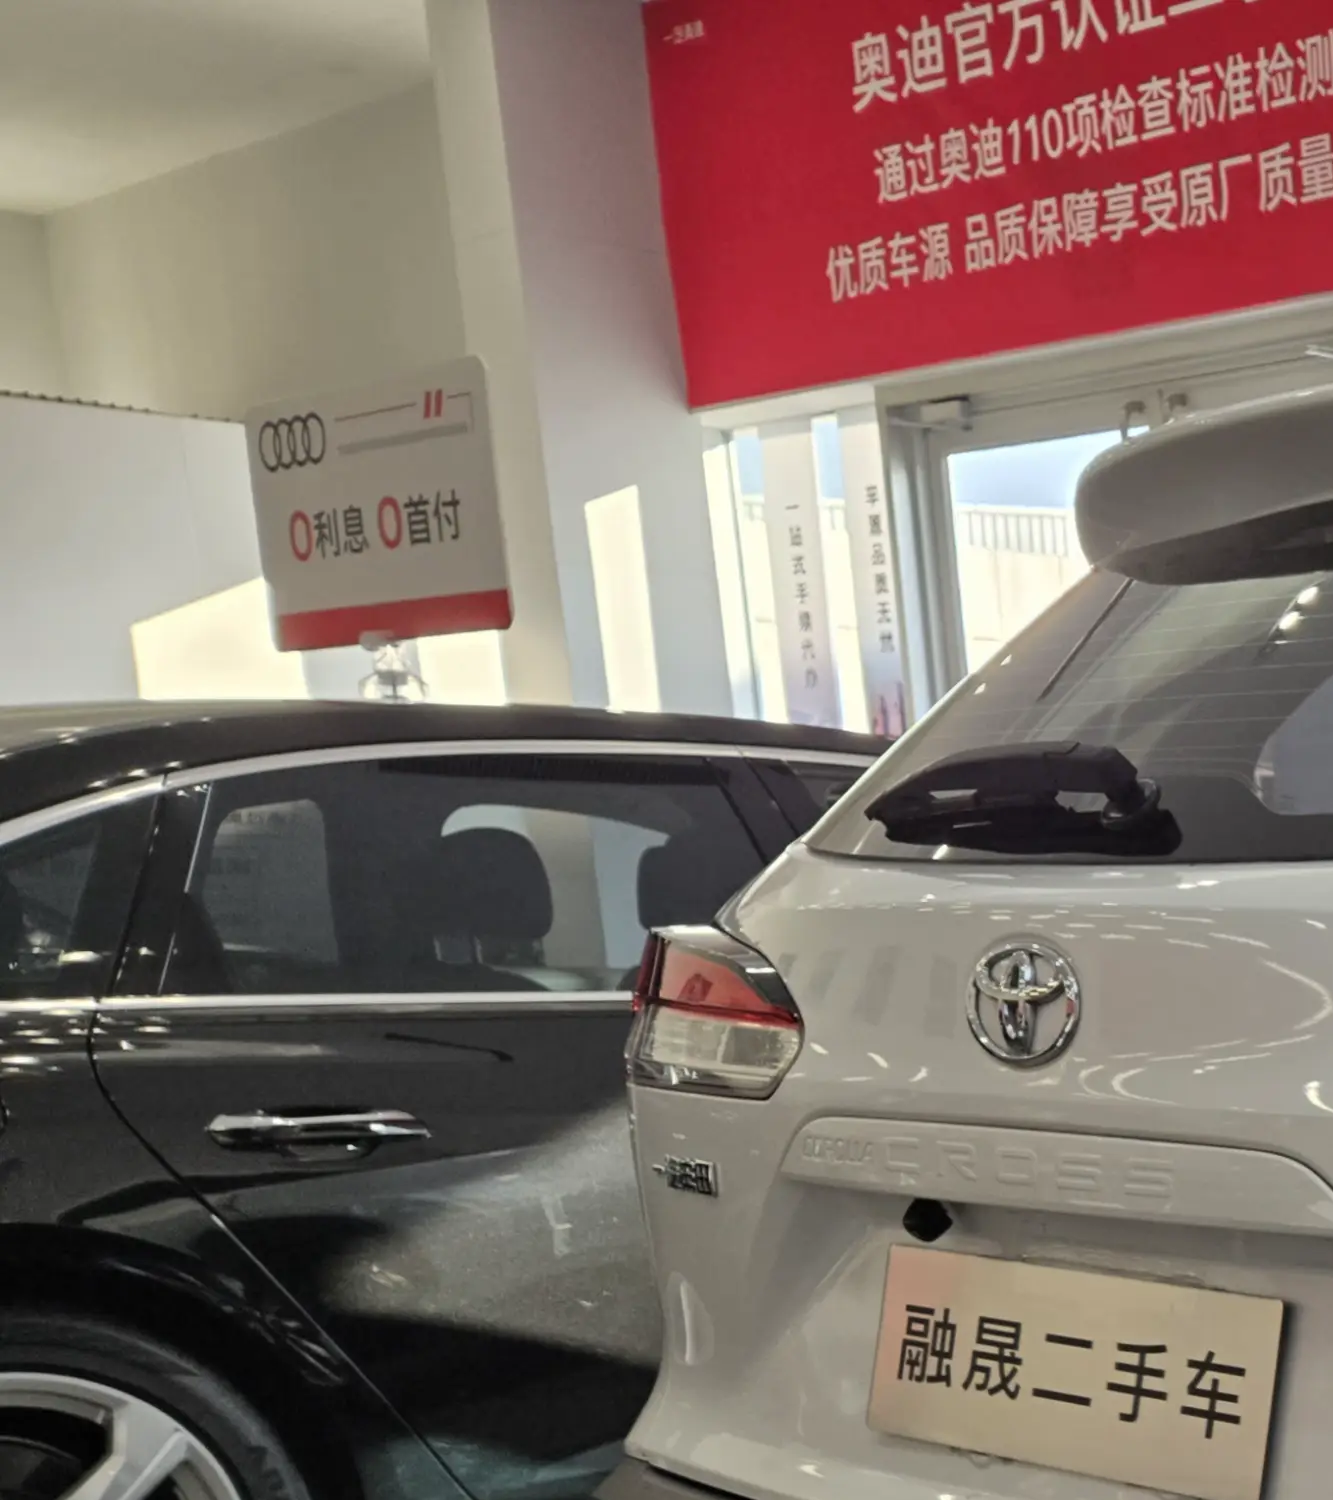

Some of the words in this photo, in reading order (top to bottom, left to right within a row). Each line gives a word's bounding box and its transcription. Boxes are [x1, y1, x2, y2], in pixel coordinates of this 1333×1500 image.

[851, 0, 1262, 113] 奥迪官方认
[824, 220, 954, 304] 优质车源
[289, 504, 370, 562] 0利息
[377, 488, 461, 551] 0首付
[882, 1135, 1176, 1199] CROSS
[896, 1304, 1248, 1440] 融晟二手车
